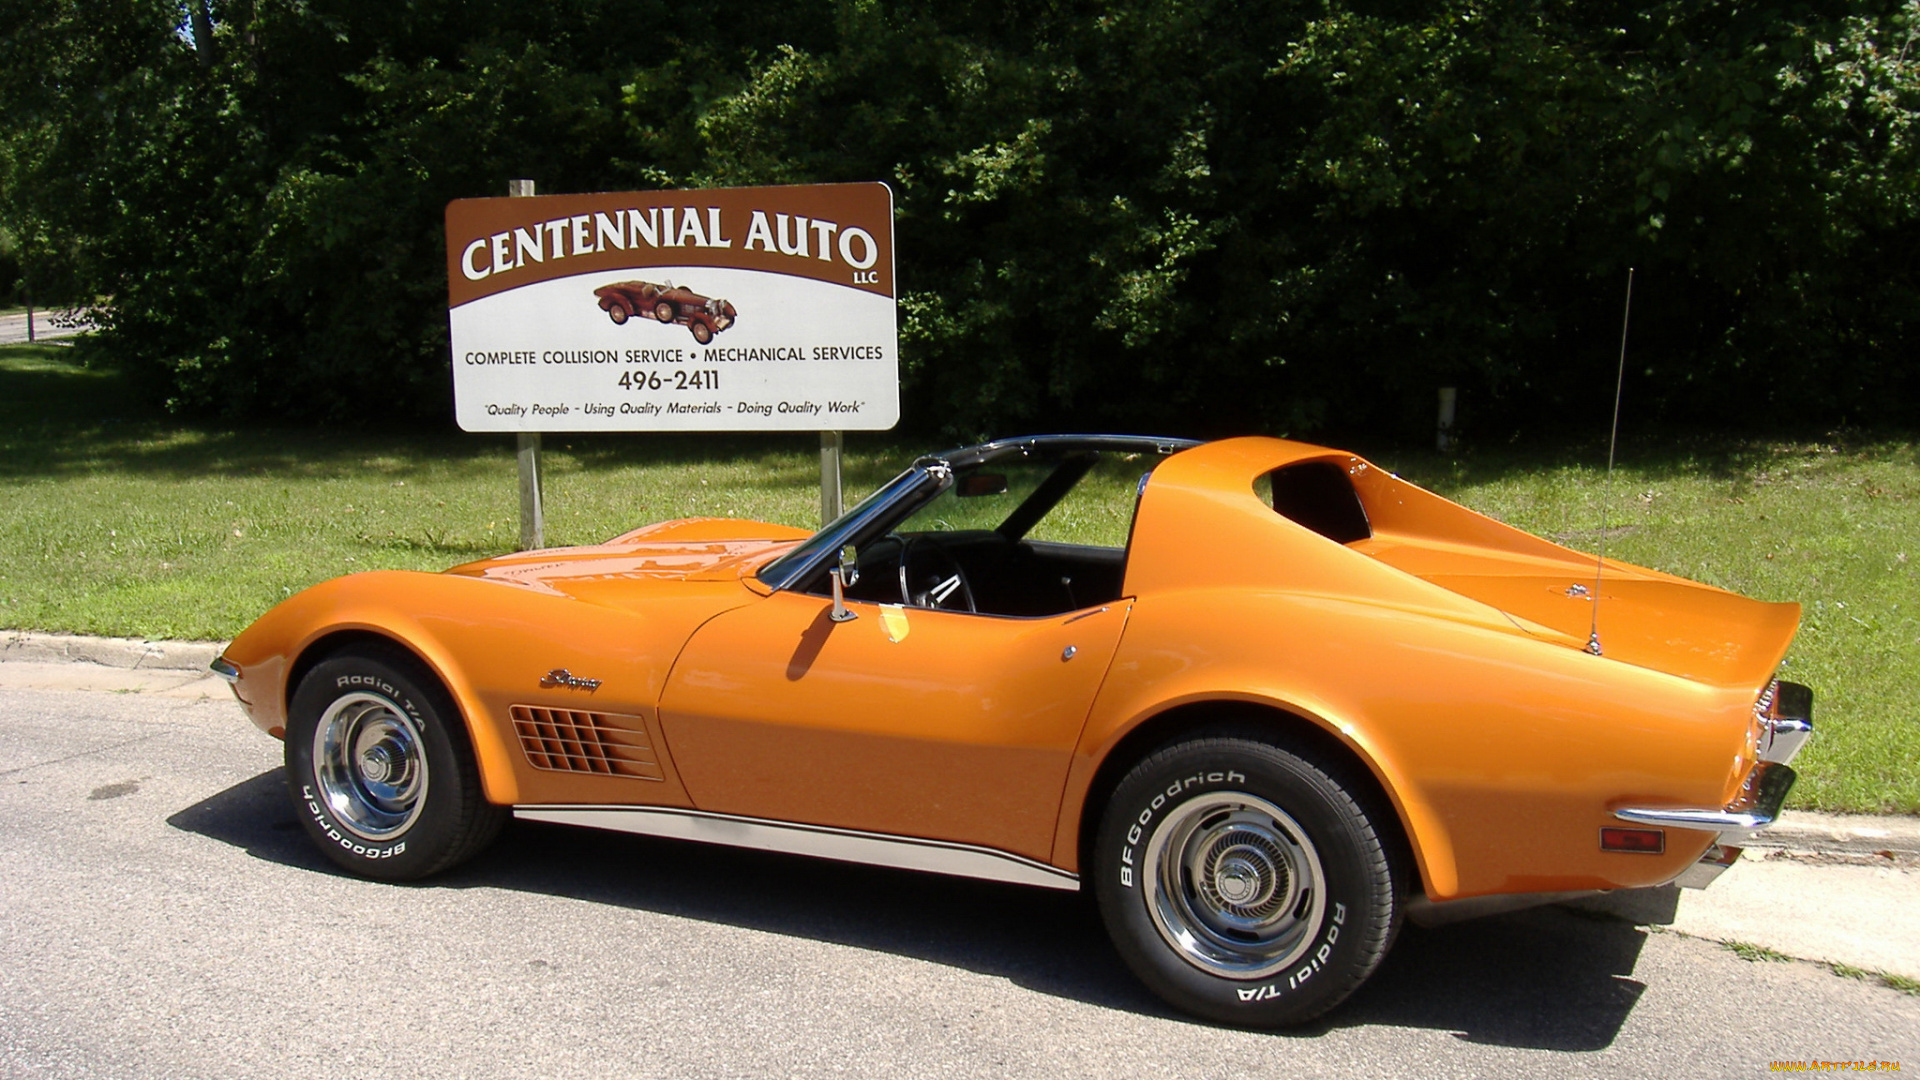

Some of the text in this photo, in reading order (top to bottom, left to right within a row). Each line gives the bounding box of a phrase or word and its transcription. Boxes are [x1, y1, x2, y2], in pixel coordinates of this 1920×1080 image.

[461, 206, 879, 281] CENTENNIAL AUTO
[853, 271, 879, 284] LLC
[465, 346, 883, 365] COMPLETE COLLISION SERVICE MECHANICAL SERVICES
[618, 370, 719, 390] 496-2411
[532, 404, 570, 417] People
[584, 403, 616, 417] Using
[620, 402, 662, 416] Quality
[666, 402, 722, 414] Materials
[737, 401, 773, 416] Doing
[777, 401, 822, 416] Quality
[336, 674, 399, 698] Radial
[301, 785, 406, 859] BFGoodrich
[1120, 770, 1246, 888] BFGoodrich
[1236, 902, 1346, 1002] Radial T/A
